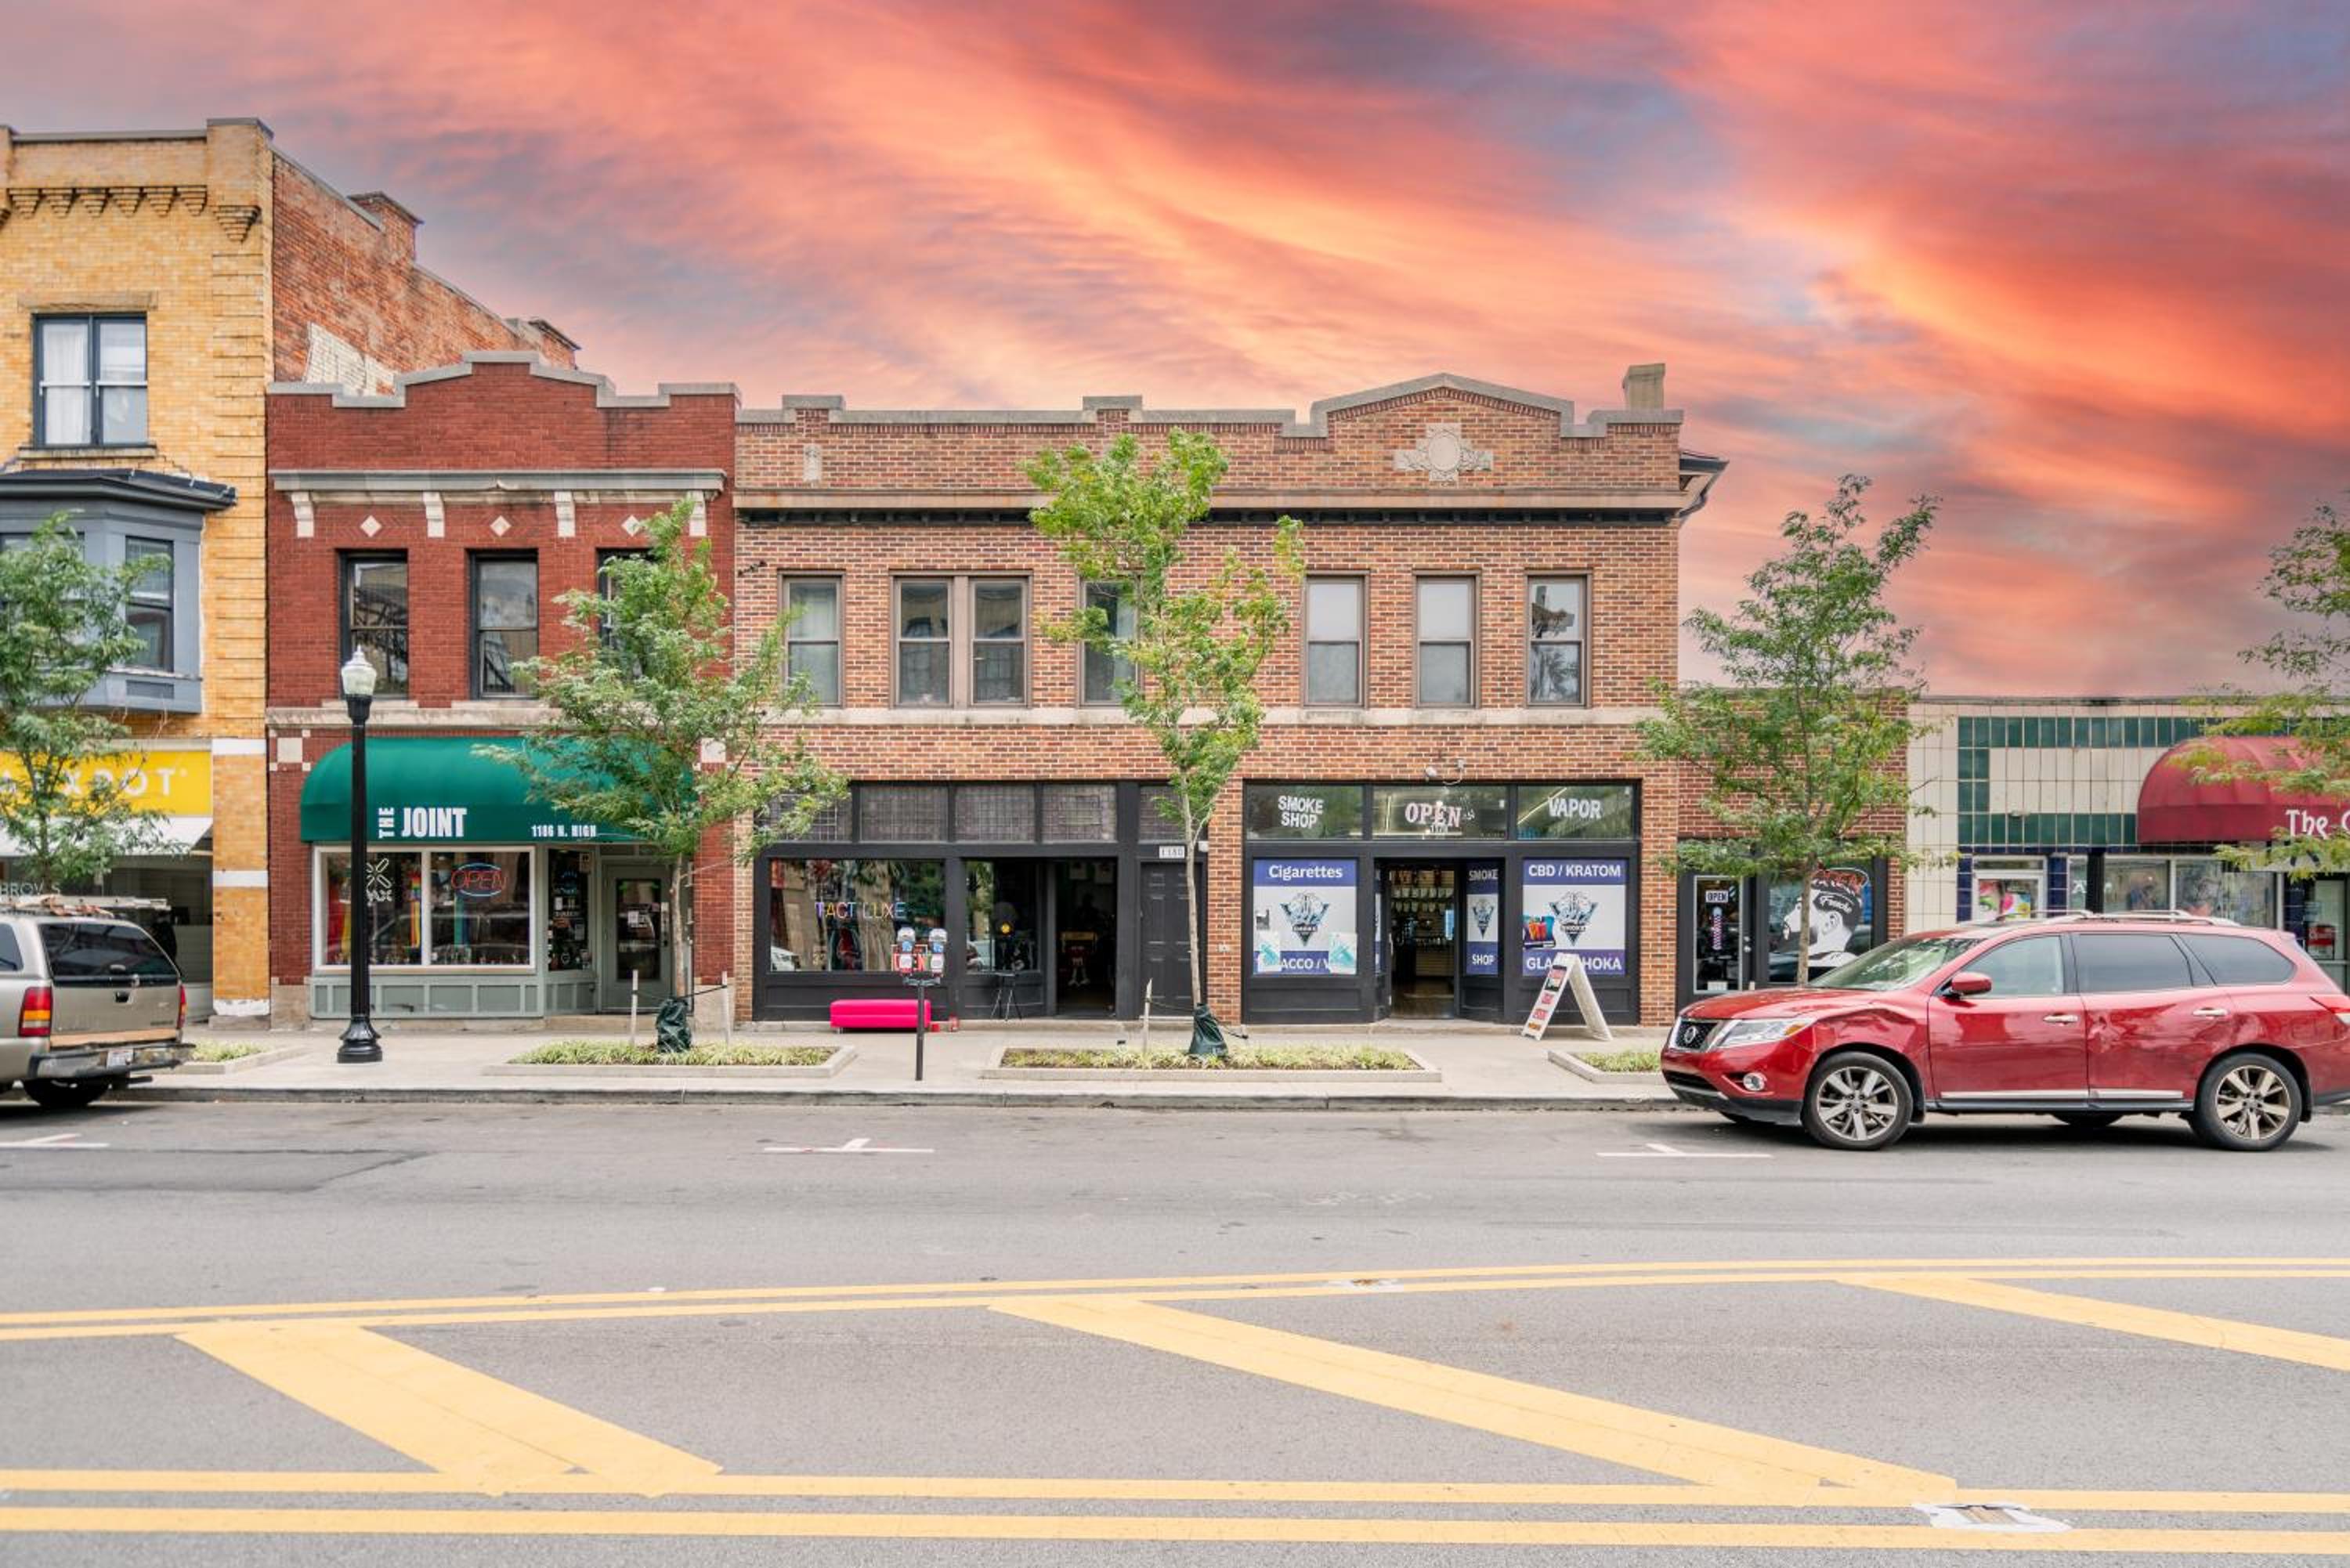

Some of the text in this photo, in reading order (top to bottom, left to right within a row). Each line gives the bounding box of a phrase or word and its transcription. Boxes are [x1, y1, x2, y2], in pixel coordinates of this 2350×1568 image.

[1278, 795, 1324, 815] SMOKE
[1405, 802, 1462, 827] OPEN
[1547, 798, 1603, 820] VAPOR
[378, 807, 394, 839] THE
[401, 807, 468, 838] JOINT
[1281, 811, 1318, 829] SHOP
[2285, 809, 2329, 840] The
[571, 825, 596, 837] HIGH
[451, 869, 508, 890] OPEN
[1268, 865, 1343, 881] Cigarettes
[1469, 869, 1498, 881] SMOKE
[1528, 865, 1622, 877] CBD / KRATOM
[815, 902, 906, 919] TACT LUXE
[1472, 954, 1495, 965] SHOP
